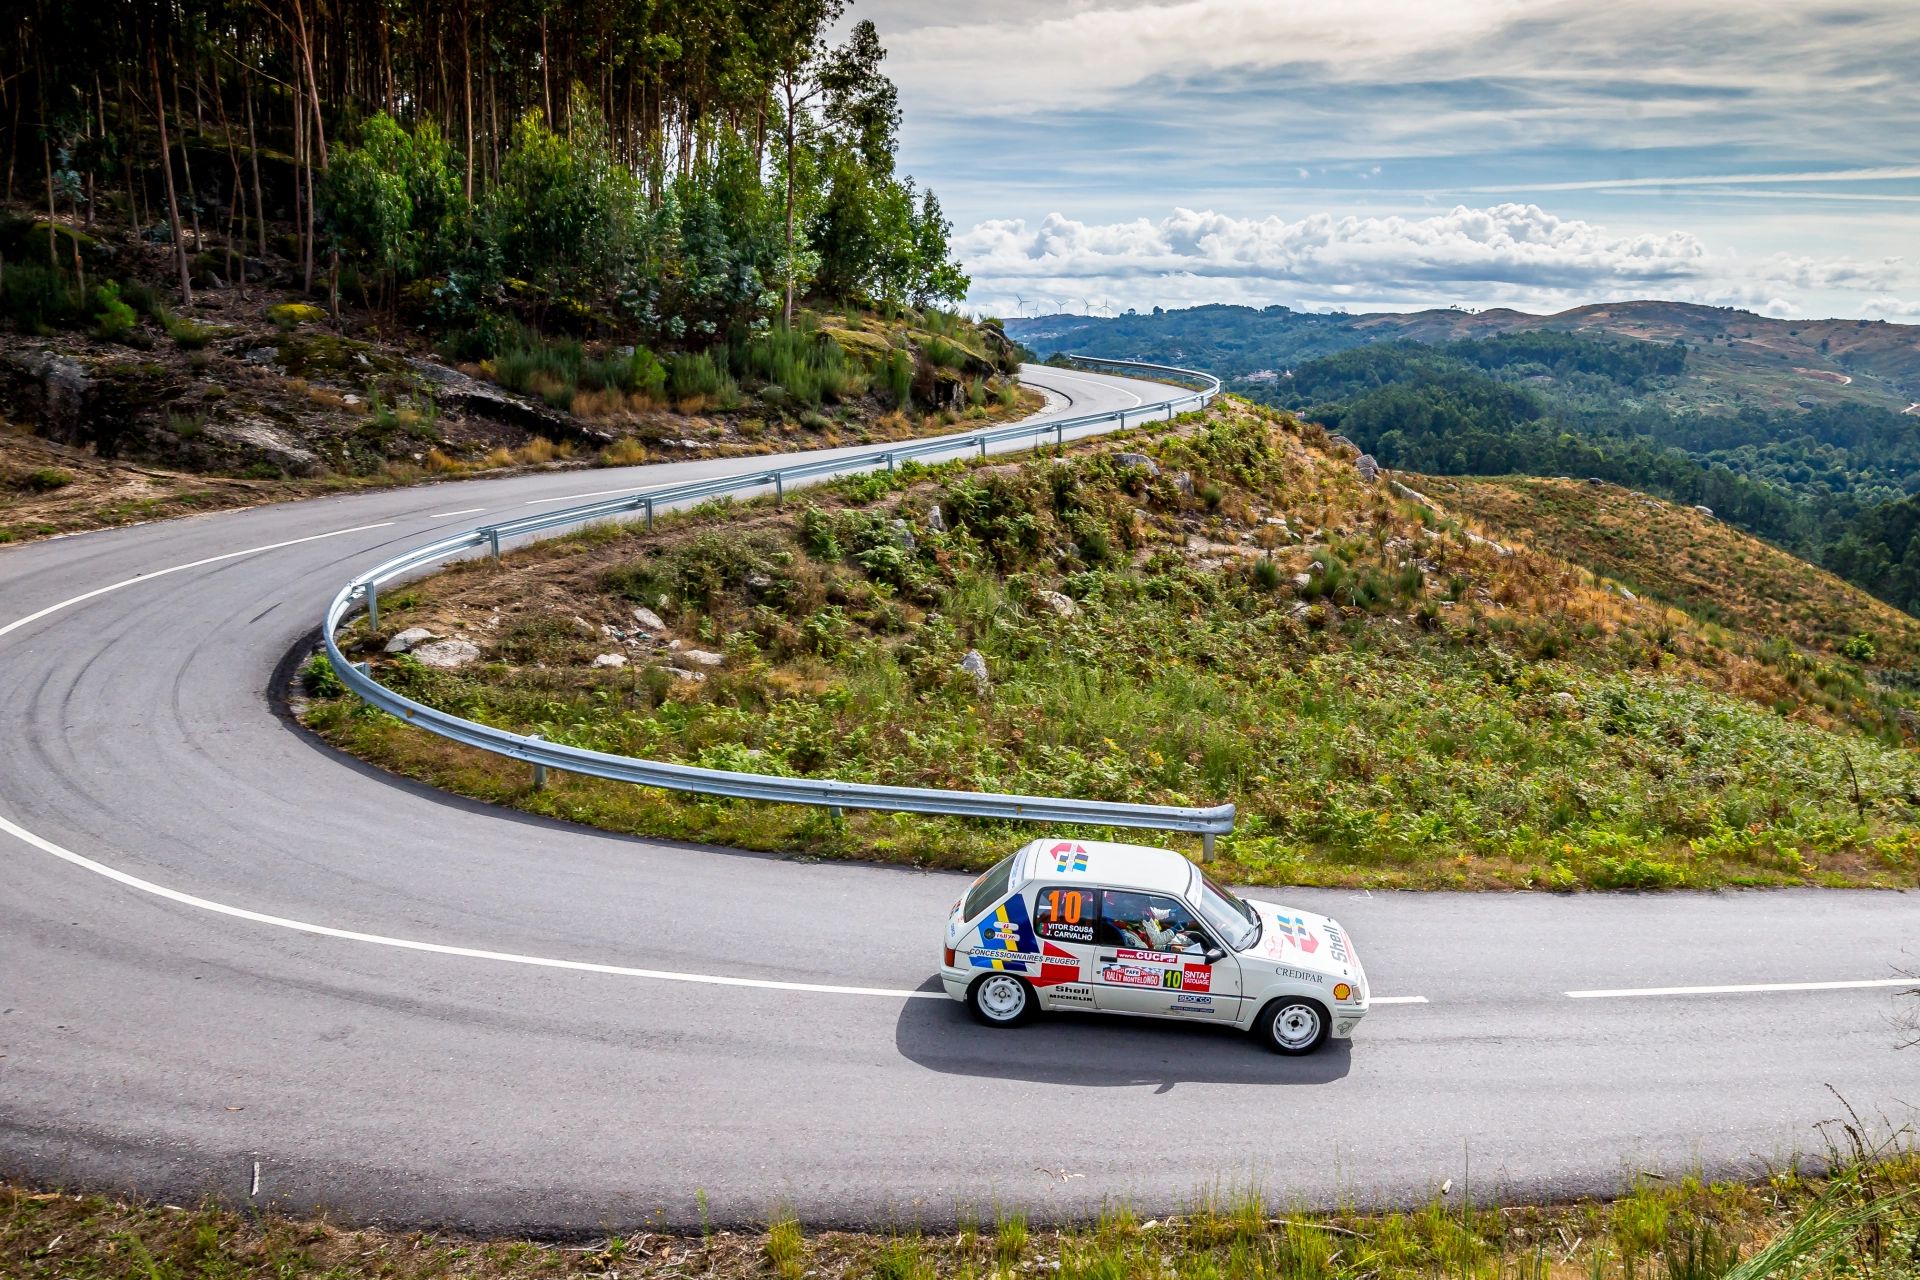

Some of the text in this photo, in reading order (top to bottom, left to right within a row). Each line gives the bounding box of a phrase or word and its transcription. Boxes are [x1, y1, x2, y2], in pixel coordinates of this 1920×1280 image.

[1048, 890, 1082, 923] 10
[1048, 923, 1094, 934] VITOR SOUSA
[1054, 931, 1093, 941] CARVALHO
[1323, 925, 1348, 963] Shell
[969, 948, 1081, 966] CONCESSIONNAIRES PEUGEOT
[1105, 970, 1123, 982] RALLY
[1165, 970, 1182, 988] 10
[1184, 970, 1211, 980] SNTAF
[1275, 966, 1323, 983] CREDIPAR
[1184, 977, 1210, 986] TATOUAGE
[1055, 985, 1089, 995] Shell
[1049, 994, 1093, 1002] MICHELIN
